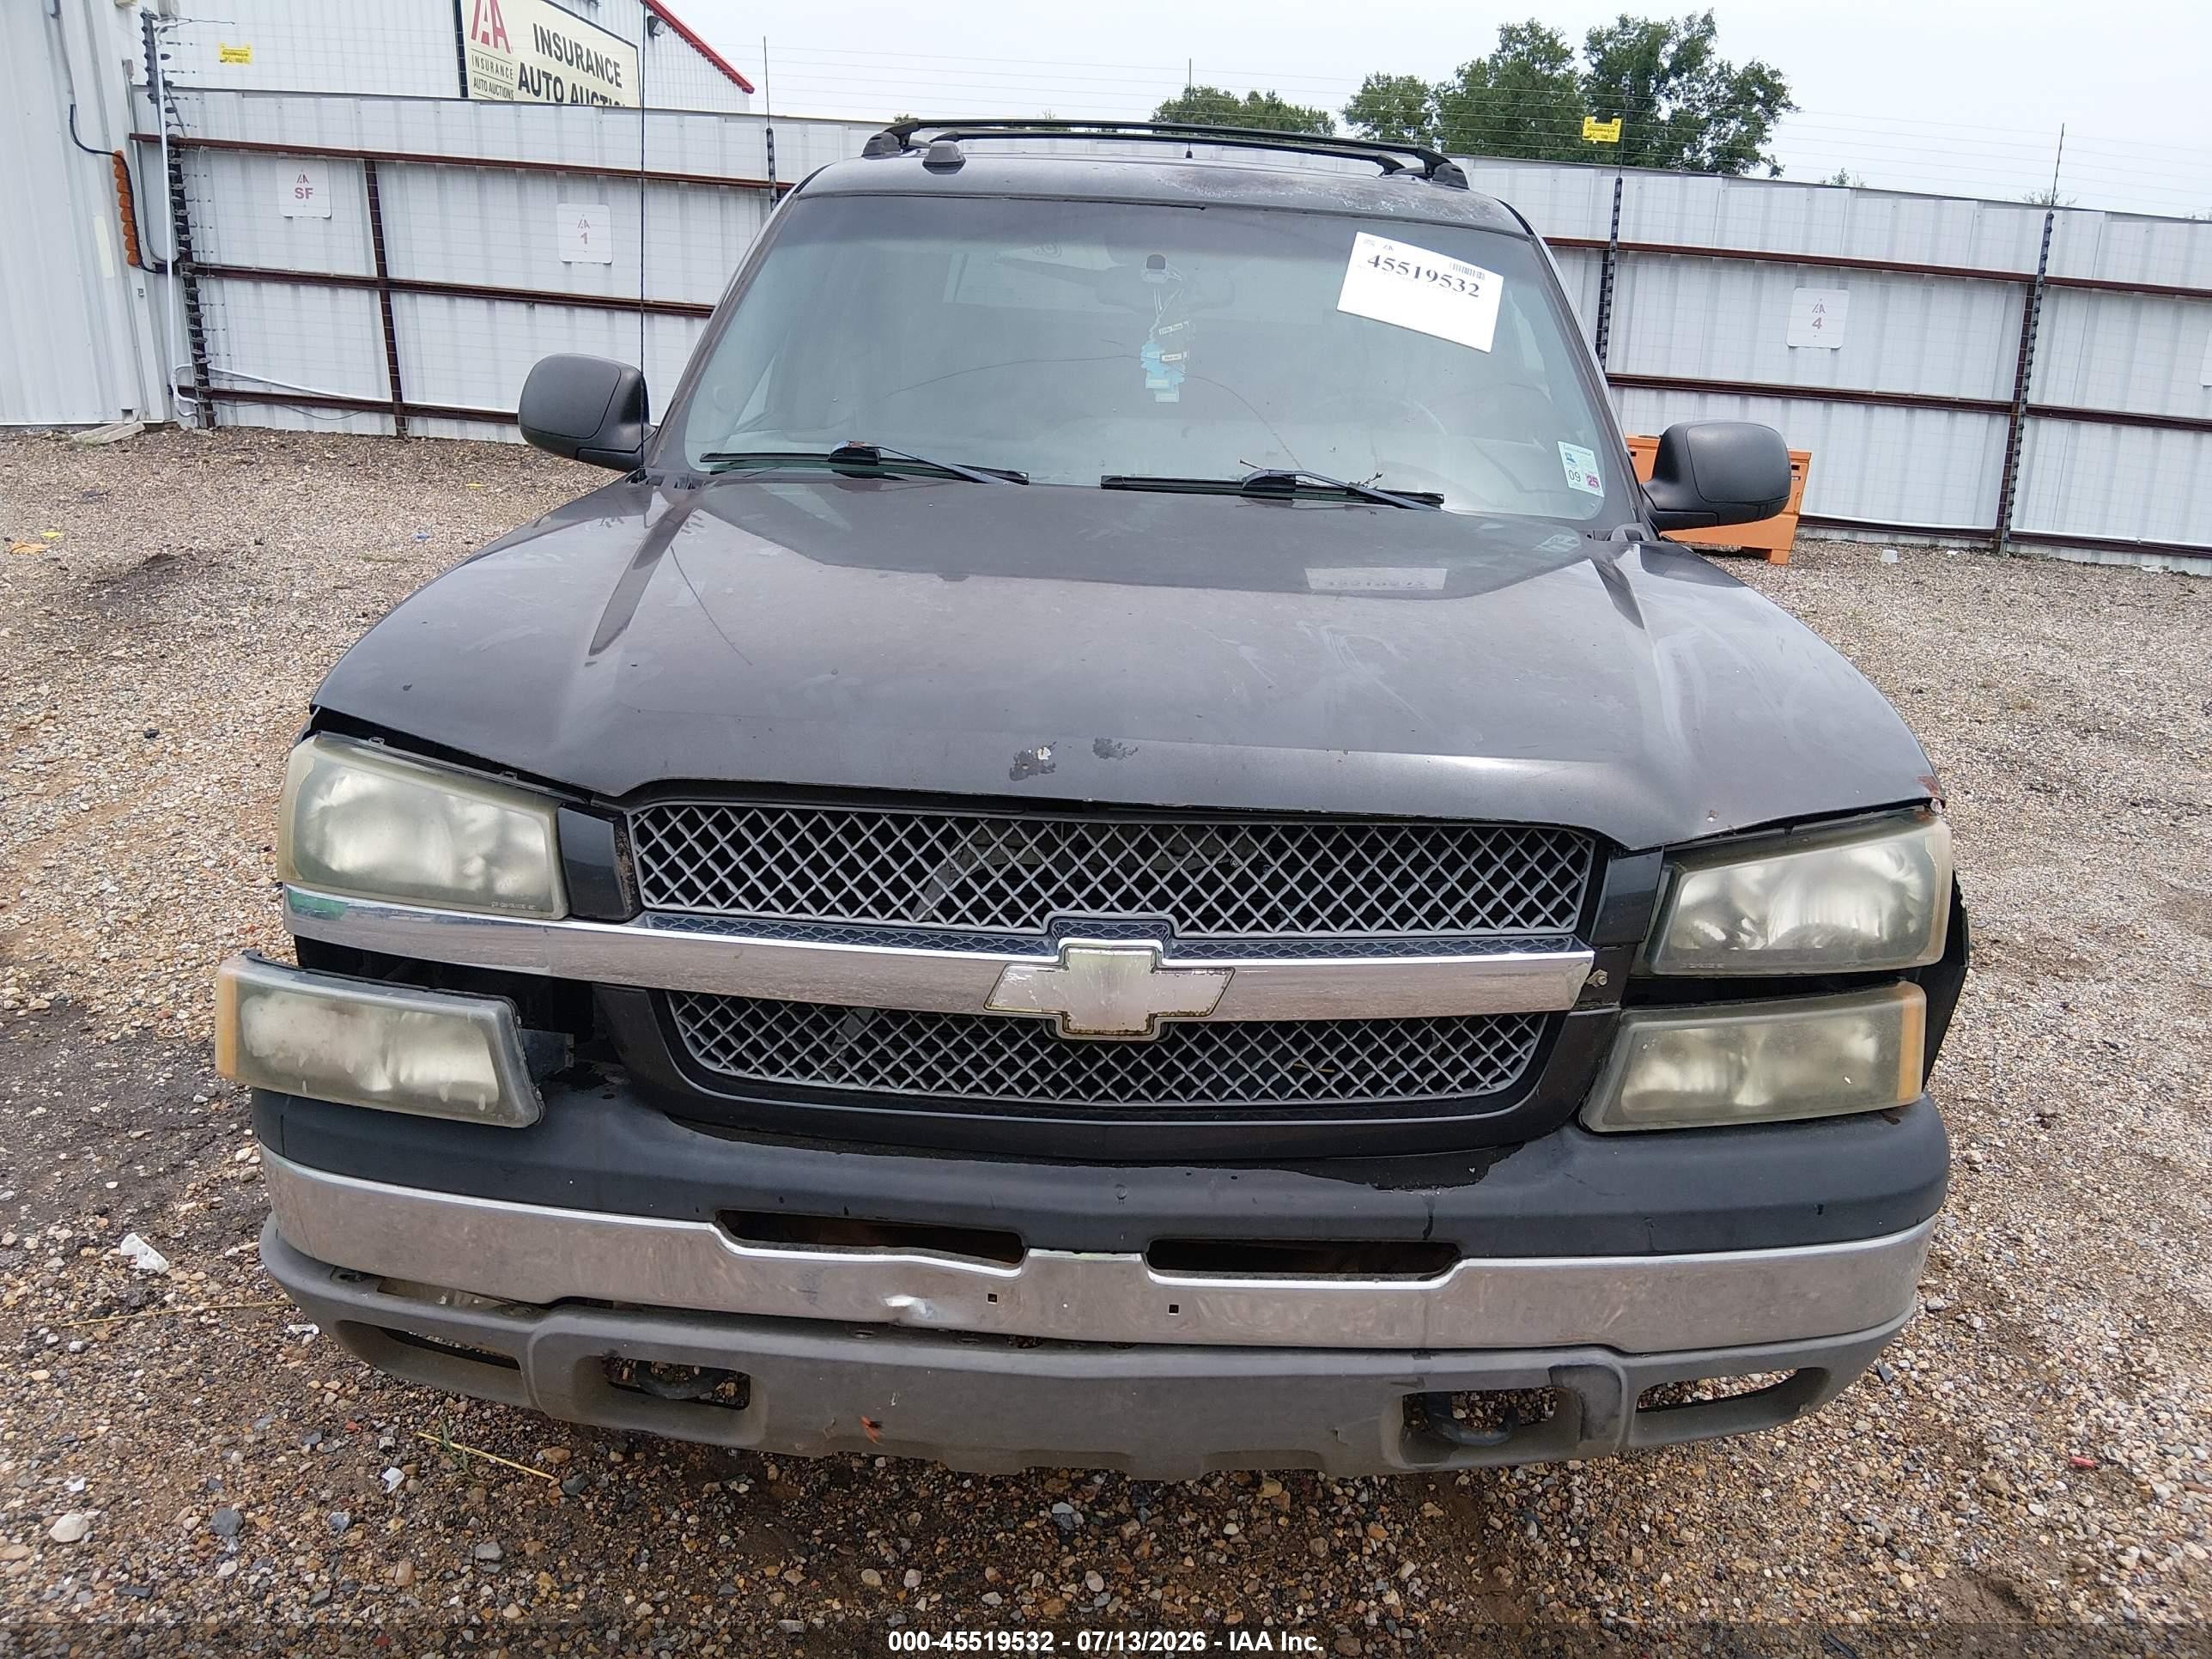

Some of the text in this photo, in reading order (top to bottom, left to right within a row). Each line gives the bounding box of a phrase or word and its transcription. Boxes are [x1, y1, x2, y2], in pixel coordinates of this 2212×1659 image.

[532, 22, 623, 88] INSURANCE
[471, 54, 514, 81] INSURANCE
[473, 76, 514, 100] AUTO AUCTIONS
[517, 62, 564, 103] AUTO
[295, 187, 313, 199] SF
[580, 232, 588, 245] 1
[1367, 254, 1480, 298] 45519532
[1812, 317, 1822, 329] 4
[1568, 470, 1600, 488] 09 25
